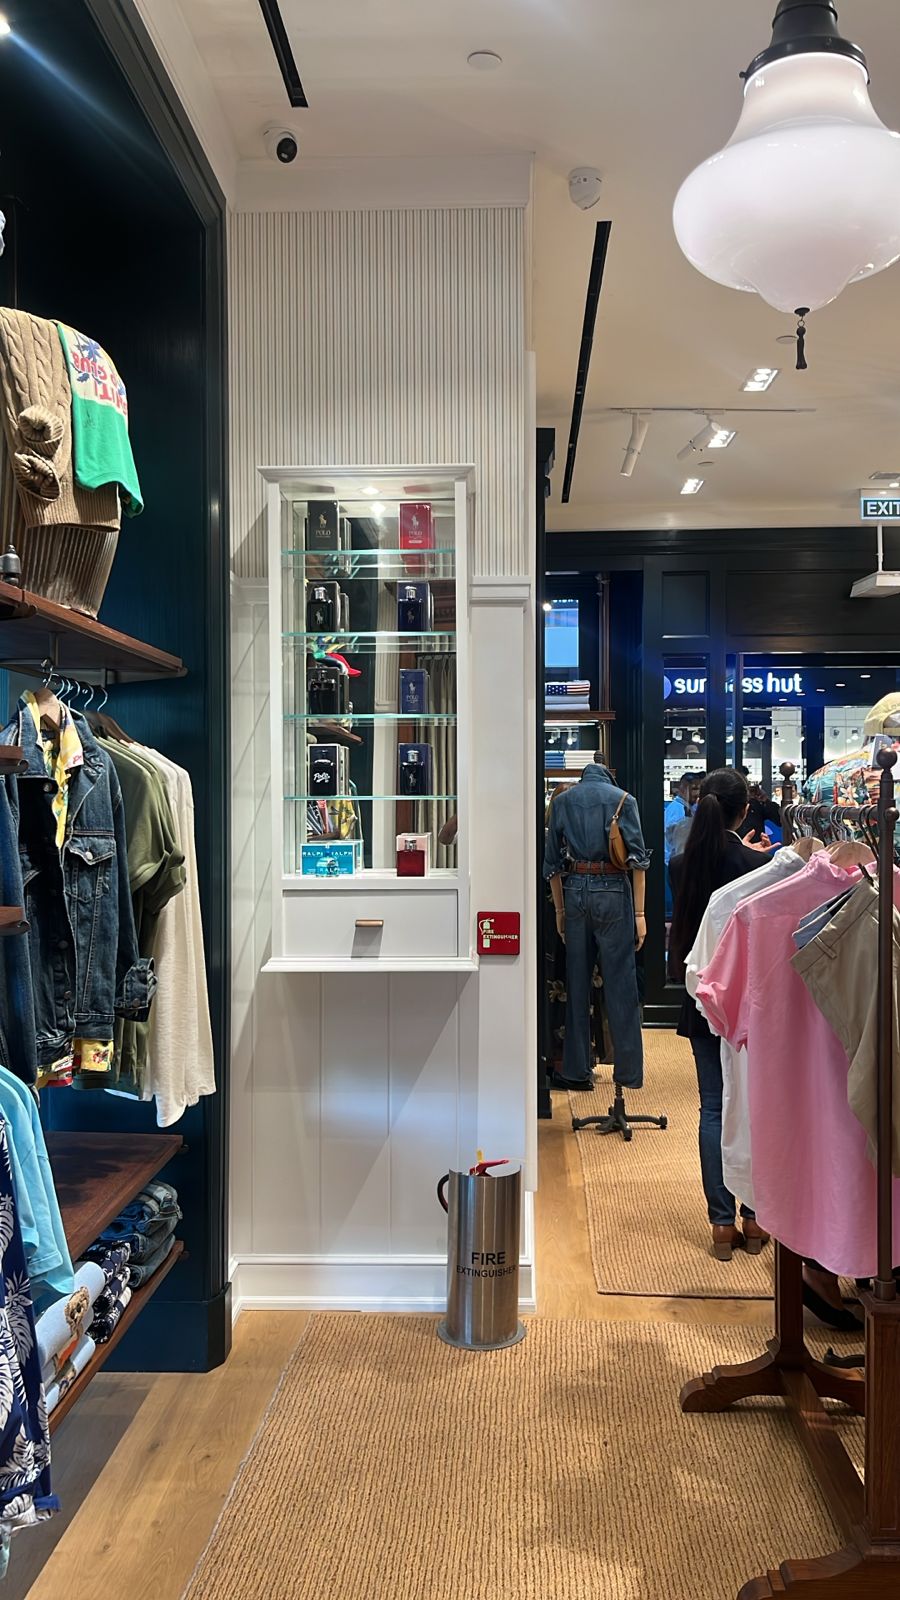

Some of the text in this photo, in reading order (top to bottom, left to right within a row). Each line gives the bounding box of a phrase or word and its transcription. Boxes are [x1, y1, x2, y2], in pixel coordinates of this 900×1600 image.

[866, 501, 900, 515] EXIT
[766, 672, 803, 693] hut
[471, 1251, 506, 1266] FIRE
[456, 1264, 517, 1278] EXTINGUISHER
